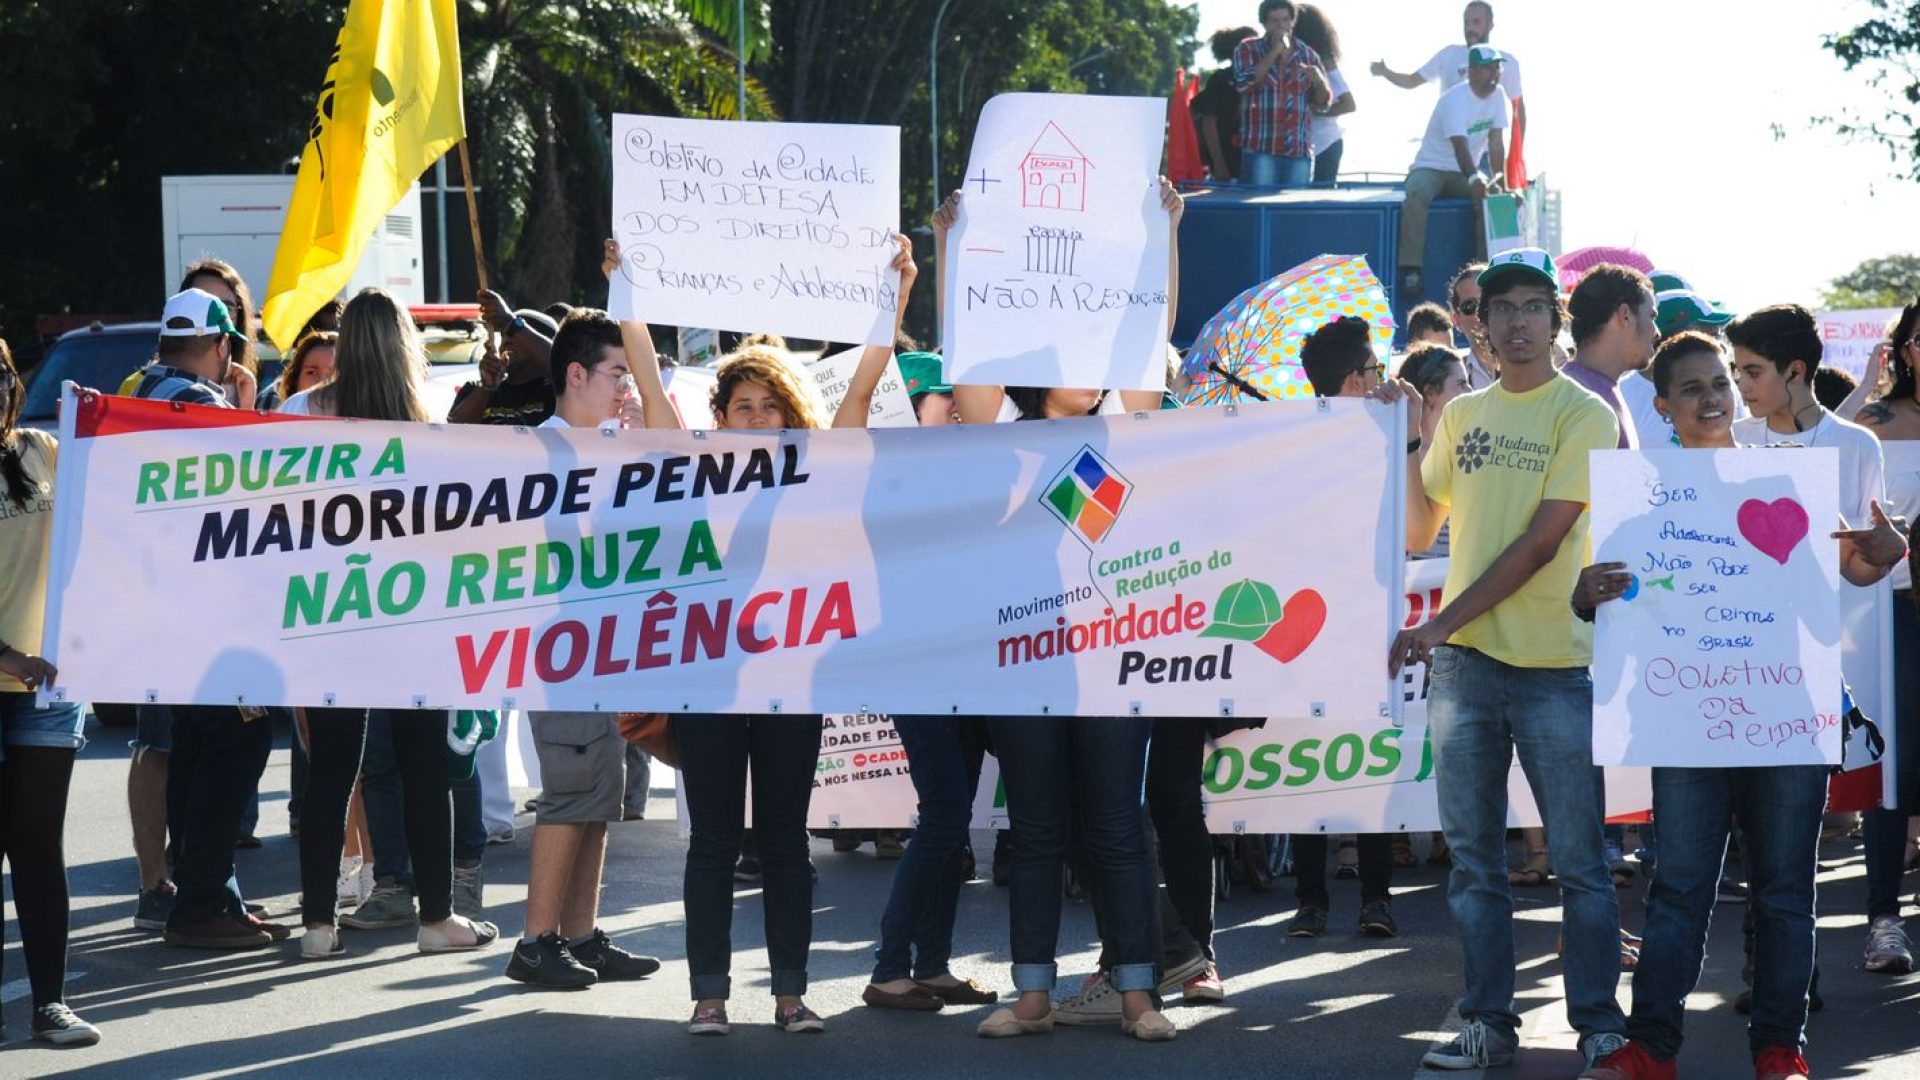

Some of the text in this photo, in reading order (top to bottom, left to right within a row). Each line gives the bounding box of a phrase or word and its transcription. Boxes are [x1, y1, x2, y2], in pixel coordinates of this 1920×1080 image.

[660, 179, 839, 218] EM DEFESA
[624, 211, 699, 235] DOS
[136, 437, 406, 504] REDUZIR A
[193, 444, 811, 563] MAIORIDADE PENAL
[1648, 483, 1698, 507] SER
[282, 519, 722, 629] NÃO REDUZ A
[1098, 540, 1181, 577] Contra a
[1116, 550, 1232, 598] Redução da
[998, 584, 1093, 625] Movimento
[455, 581, 858, 694] VIOLÊNCIA
[998, 593, 1207, 667] maioridade
[1117, 643, 1234, 686] Penal
[1645, 657, 1803, 697] COLETIVO
[843, 713, 889, 728] REDU
[877, 729, 898, 741] PE
[816, 750, 908, 774] ÇÃO CADE
[852, 767, 892, 780] NESSA
[1203, 728, 1404, 795] OSSOS
